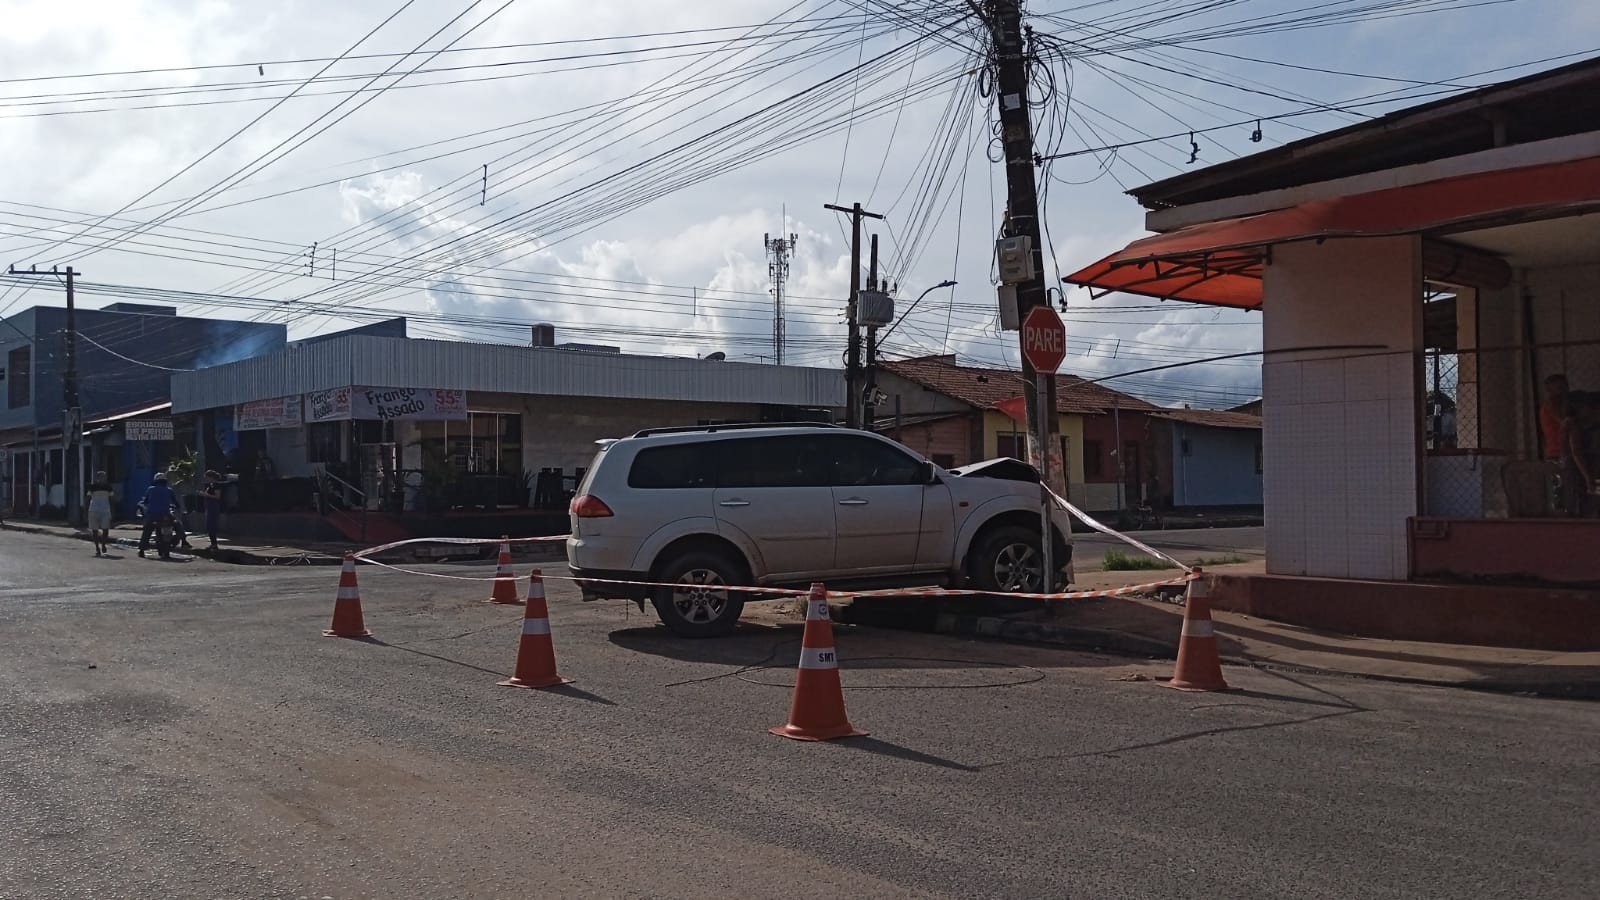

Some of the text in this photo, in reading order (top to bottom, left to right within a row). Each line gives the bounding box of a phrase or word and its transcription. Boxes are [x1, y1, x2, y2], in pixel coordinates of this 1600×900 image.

[1026, 327, 1062, 353] PARE
[365, 388, 416, 405] Frango
[377, 399, 425, 420] Assado
